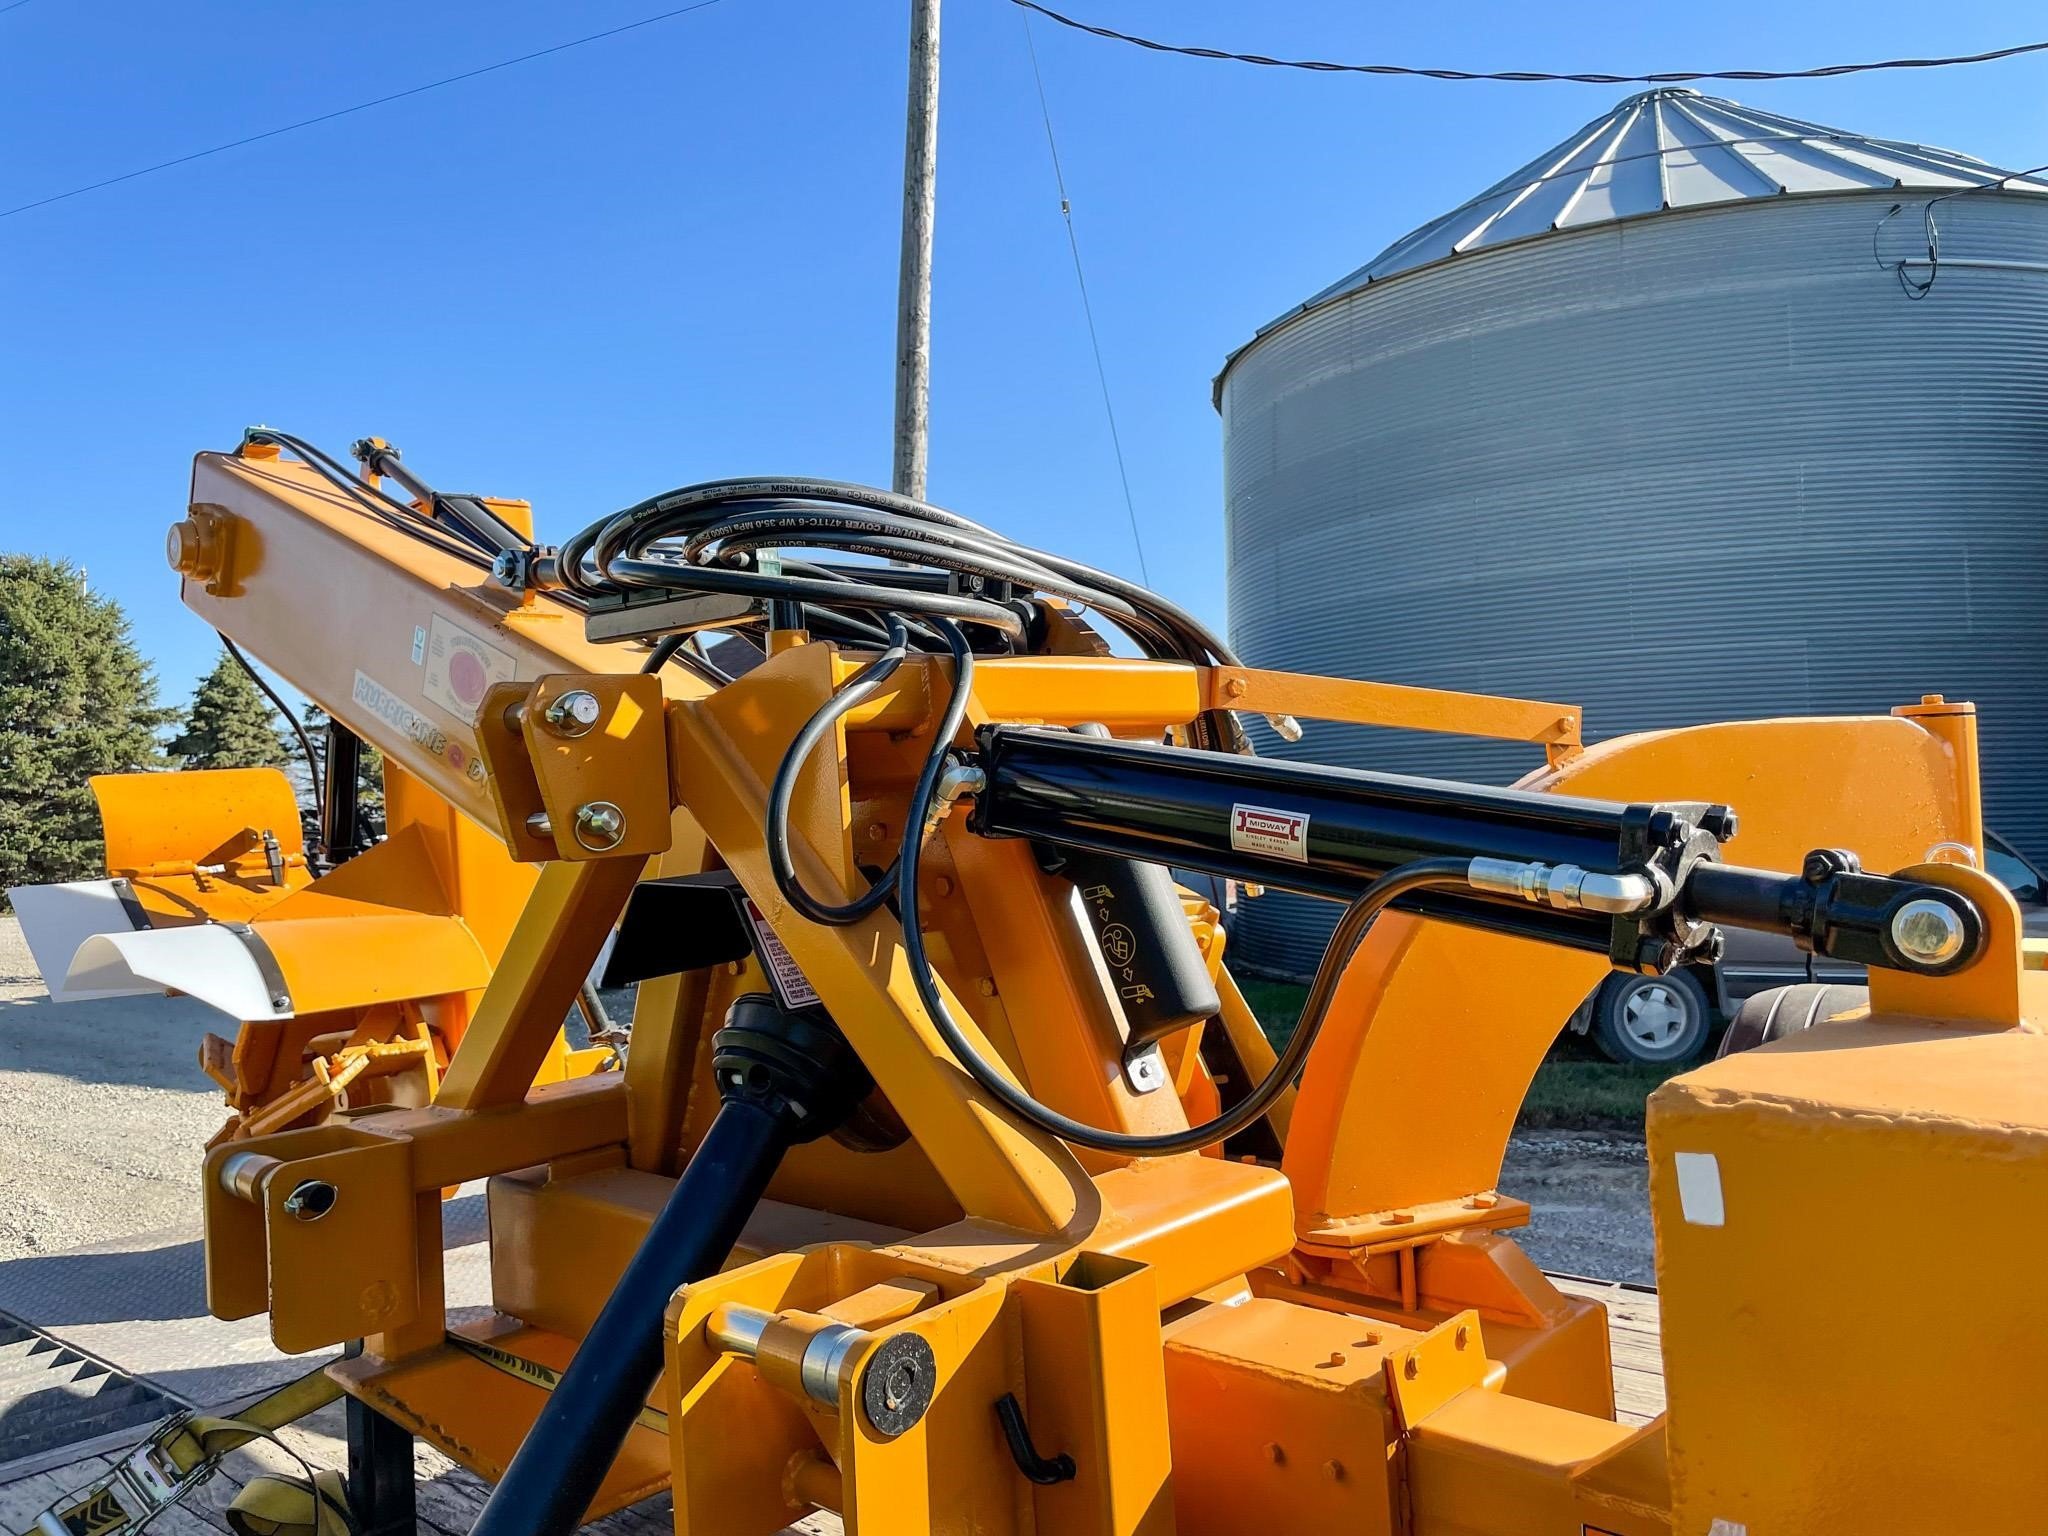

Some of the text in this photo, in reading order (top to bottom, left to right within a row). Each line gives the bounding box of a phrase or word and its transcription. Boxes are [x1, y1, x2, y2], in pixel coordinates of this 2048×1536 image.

[771, 485, 798, 493] MSHA
[911, 504, 927, 516] MPa
[733, 521, 754, 531] MPa
[779, 518, 796, 527] WP
[845, 520, 881, 532] COVER
[710, 526, 734, 538] (5000
[892, 549, 921, 561] MSHA
[355, 677, 447, 756] HURRICANE
[1249, 820, 1287, 832] MIDWAY
